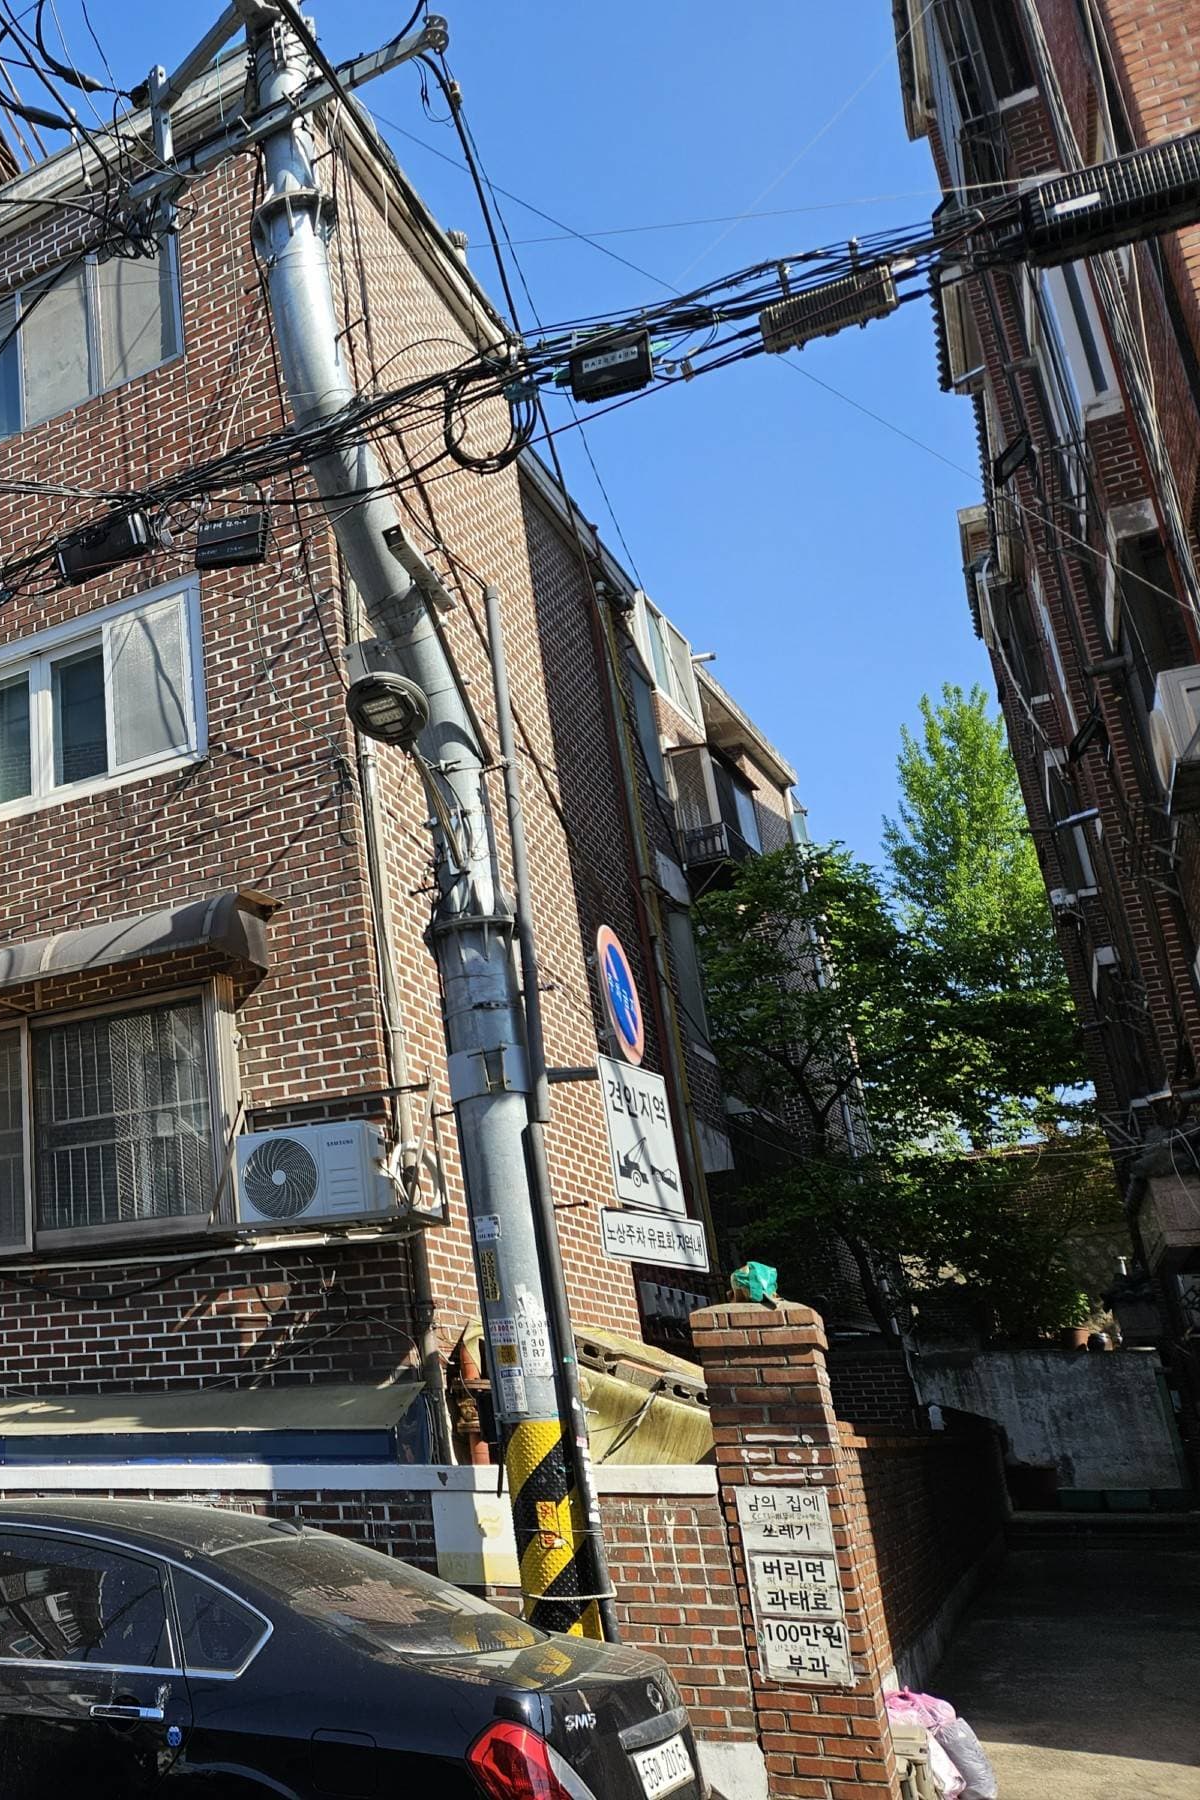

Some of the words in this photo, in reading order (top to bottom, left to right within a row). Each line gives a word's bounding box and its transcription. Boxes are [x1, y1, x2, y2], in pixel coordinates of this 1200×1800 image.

[608, 1079, 668, 1129] 견인지역
[606, 1221, 646, 1248] 노상주차
[647, 1227, 676, 1253] 유료화
[786, 1494, 820, 1513] 집에
[762, 1523, 811, 1541] 쓰레기
[763, 1559, 826, 1583] 버리면
[767, 1589, 833, 1612] 과태료
[765, 1622, 844, 1649] 100만원
[786, 1654, 830, 1679] 부과
[564, 1713, 597, 1730] SM5
